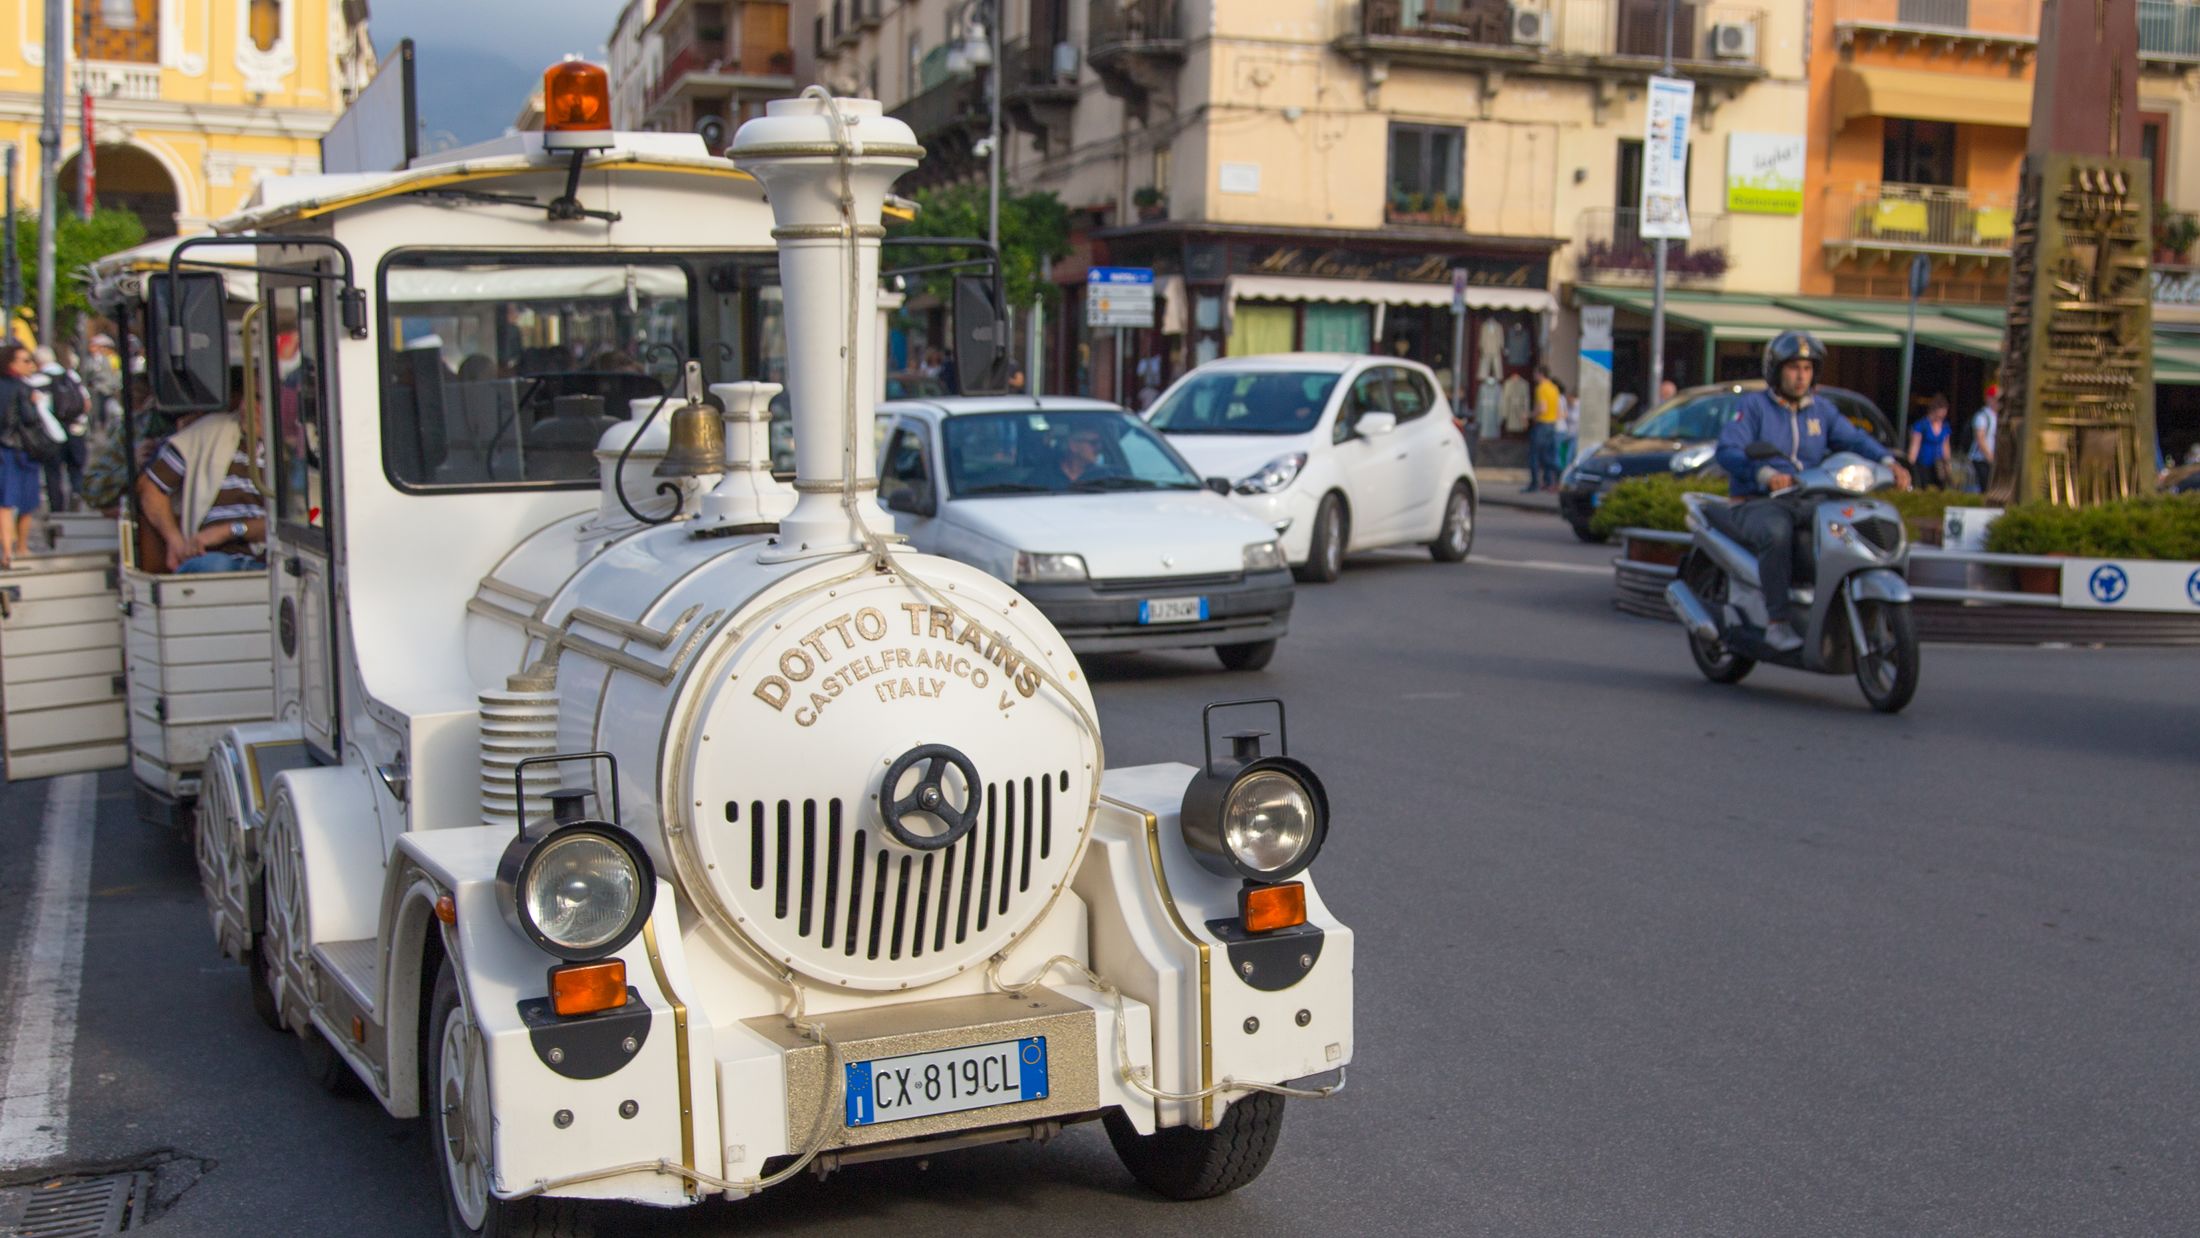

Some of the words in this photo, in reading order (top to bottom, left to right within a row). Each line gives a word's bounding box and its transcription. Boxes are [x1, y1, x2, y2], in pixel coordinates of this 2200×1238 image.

[753, 606, 887, 713] DOTTO
[901, 602, 1042, 699] TRAINS
[794, 648, 989, 728] CASTELFRANCO
[997, 690, 1016, 719] V.
[875, 677, 946, 703] ITALY
